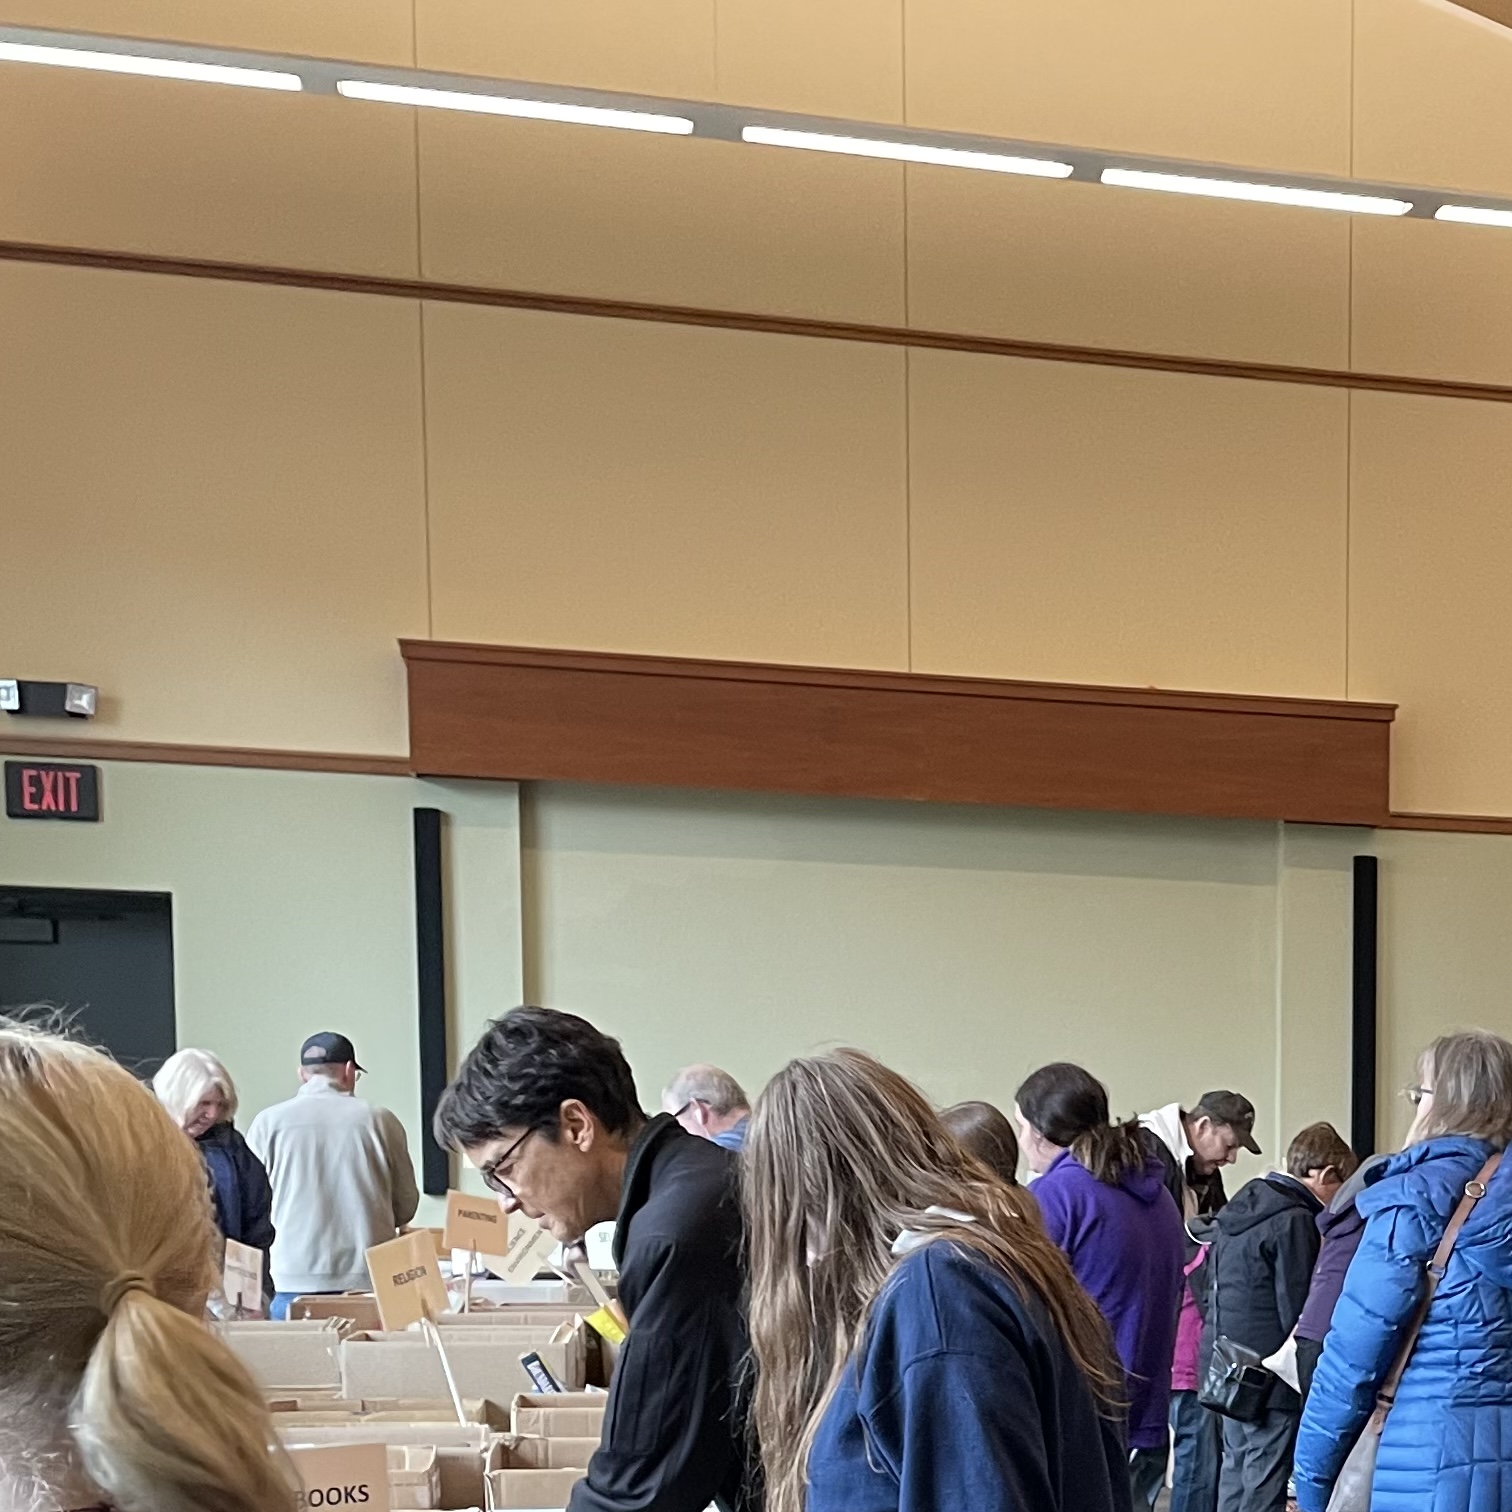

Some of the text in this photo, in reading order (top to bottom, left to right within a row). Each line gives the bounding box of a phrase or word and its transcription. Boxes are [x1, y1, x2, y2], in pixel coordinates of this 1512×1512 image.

[22, 768, 81, 812] EXIT
[458, 1209, 497, 1224] PARENTING
[393, 1265, 427, 1287] RELIGION
